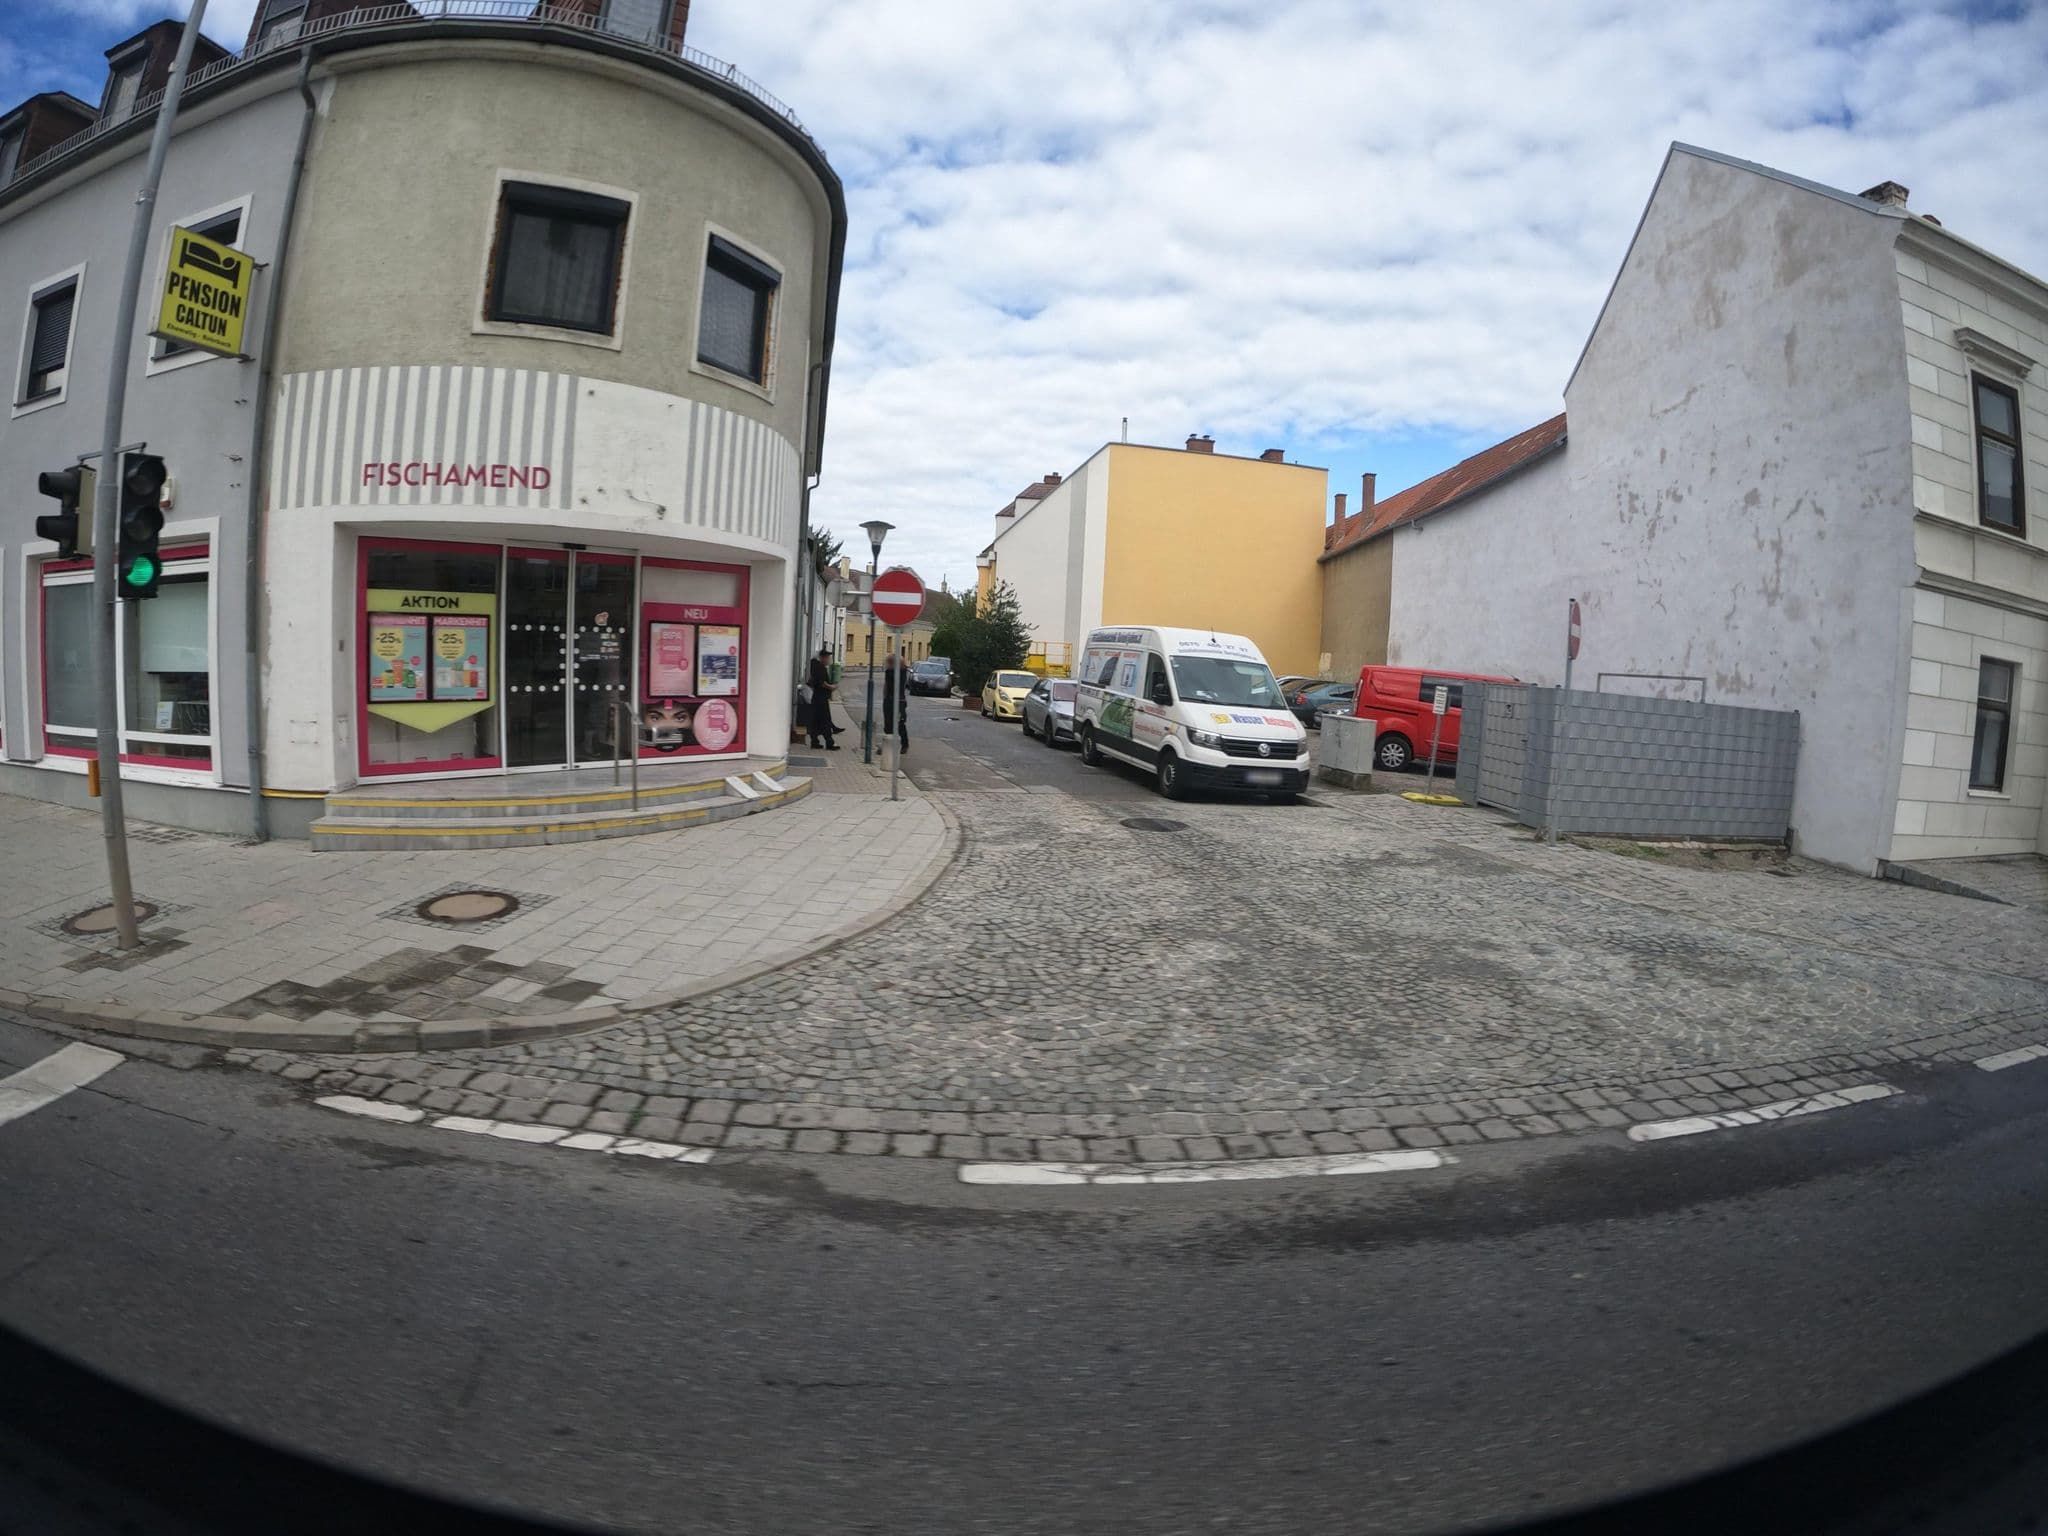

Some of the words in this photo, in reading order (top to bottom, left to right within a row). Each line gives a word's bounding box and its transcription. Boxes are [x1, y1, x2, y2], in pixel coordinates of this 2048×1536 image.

[167, 271, 242, 318] PENSION
[176, 303, 227, 337] CALTUN
[363, 462, 550, 490] FISCHAMEND
[401, 596, 460, 609] AKTION
[684, 608, 709, 620] NEU
